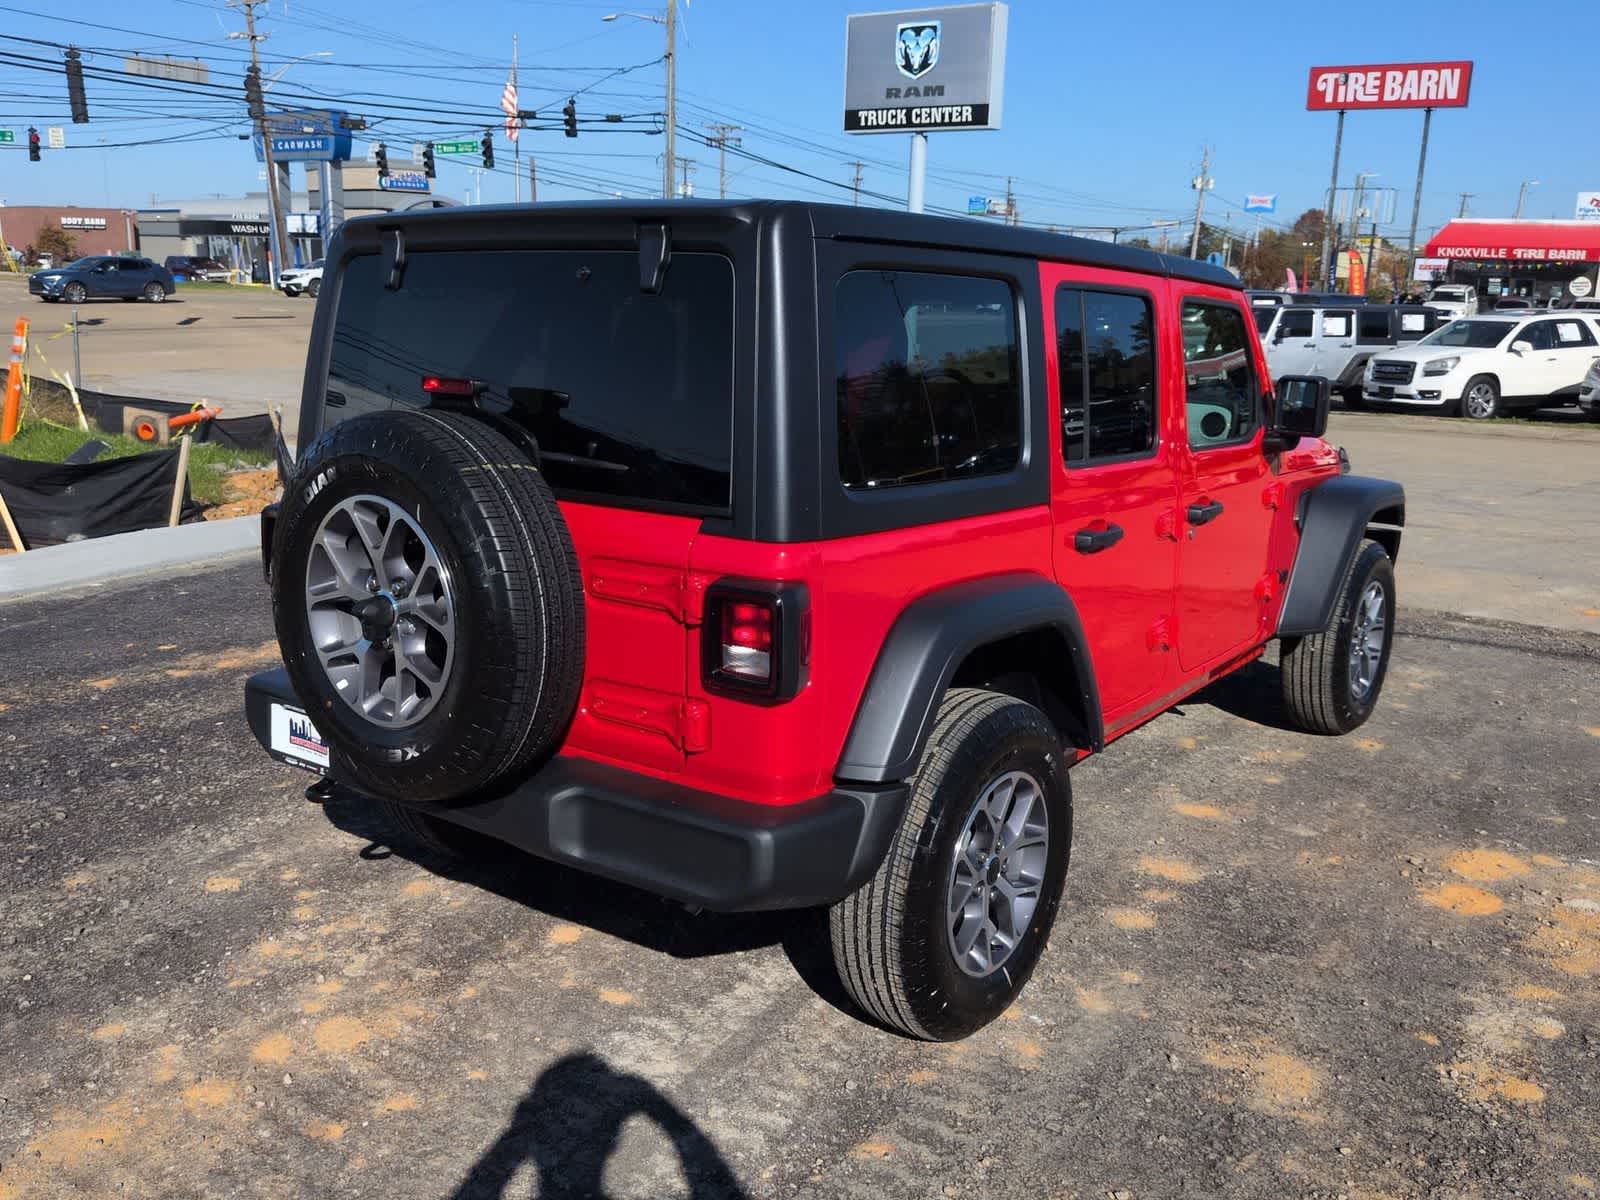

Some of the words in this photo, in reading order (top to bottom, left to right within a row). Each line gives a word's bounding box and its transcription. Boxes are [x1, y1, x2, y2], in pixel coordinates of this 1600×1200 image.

[1383, 68, 1461, 101] BARN
[885, 85, 945, 99] RAM
[858, 108, 907, 126] TRUCK
[911, 105, 973, 124] CENTER
[277, 140, 323, 150] CARWASH
[231, 224, 258, 234] WASH
[1437, 247, 1507, 259] KNOXVILLE
[1512, 248, 1545, 259] TIRE
[1548, 249, 1587, 260] BARN
